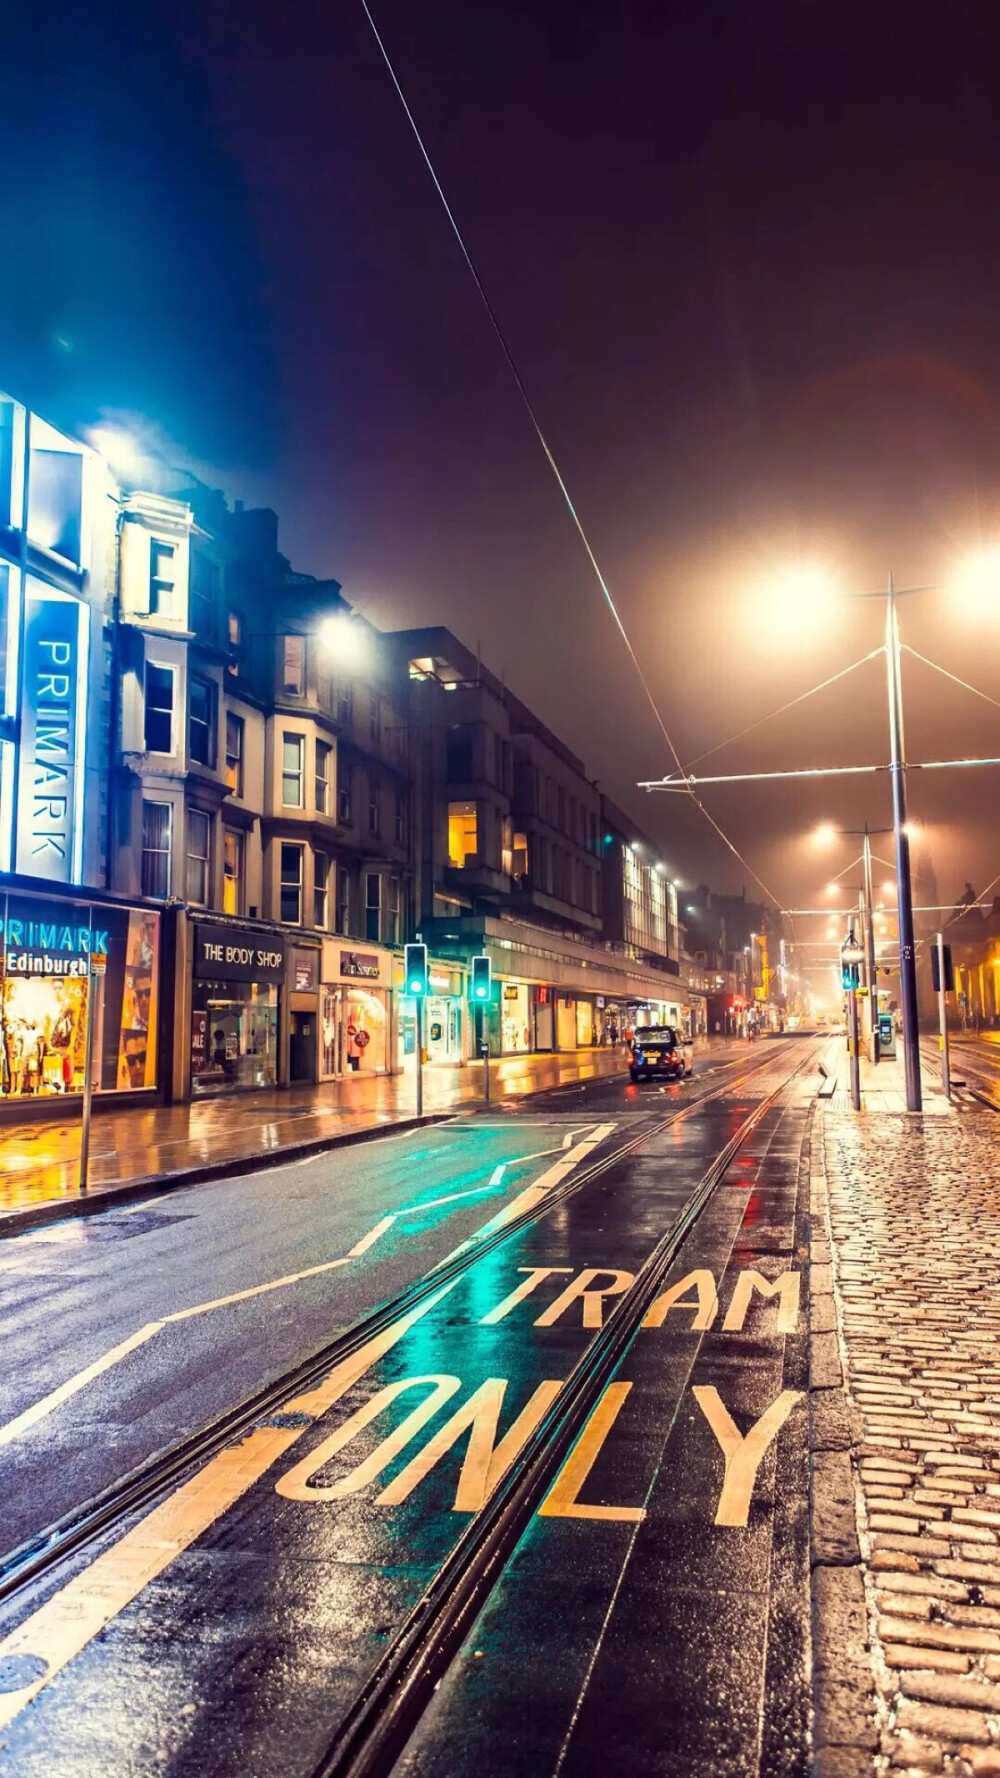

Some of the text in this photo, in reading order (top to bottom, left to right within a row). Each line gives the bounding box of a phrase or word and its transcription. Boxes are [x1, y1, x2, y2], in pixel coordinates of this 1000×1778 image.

[32, 640, 70, 858] PRIMARK
[7, 952, 87, 977] Edinburgh
[203, 943, 282, 968] THE BODY SHOP
[479, 1267, 801, 1334] TRAM
[275, 1374, 807, 1528] ONLY
